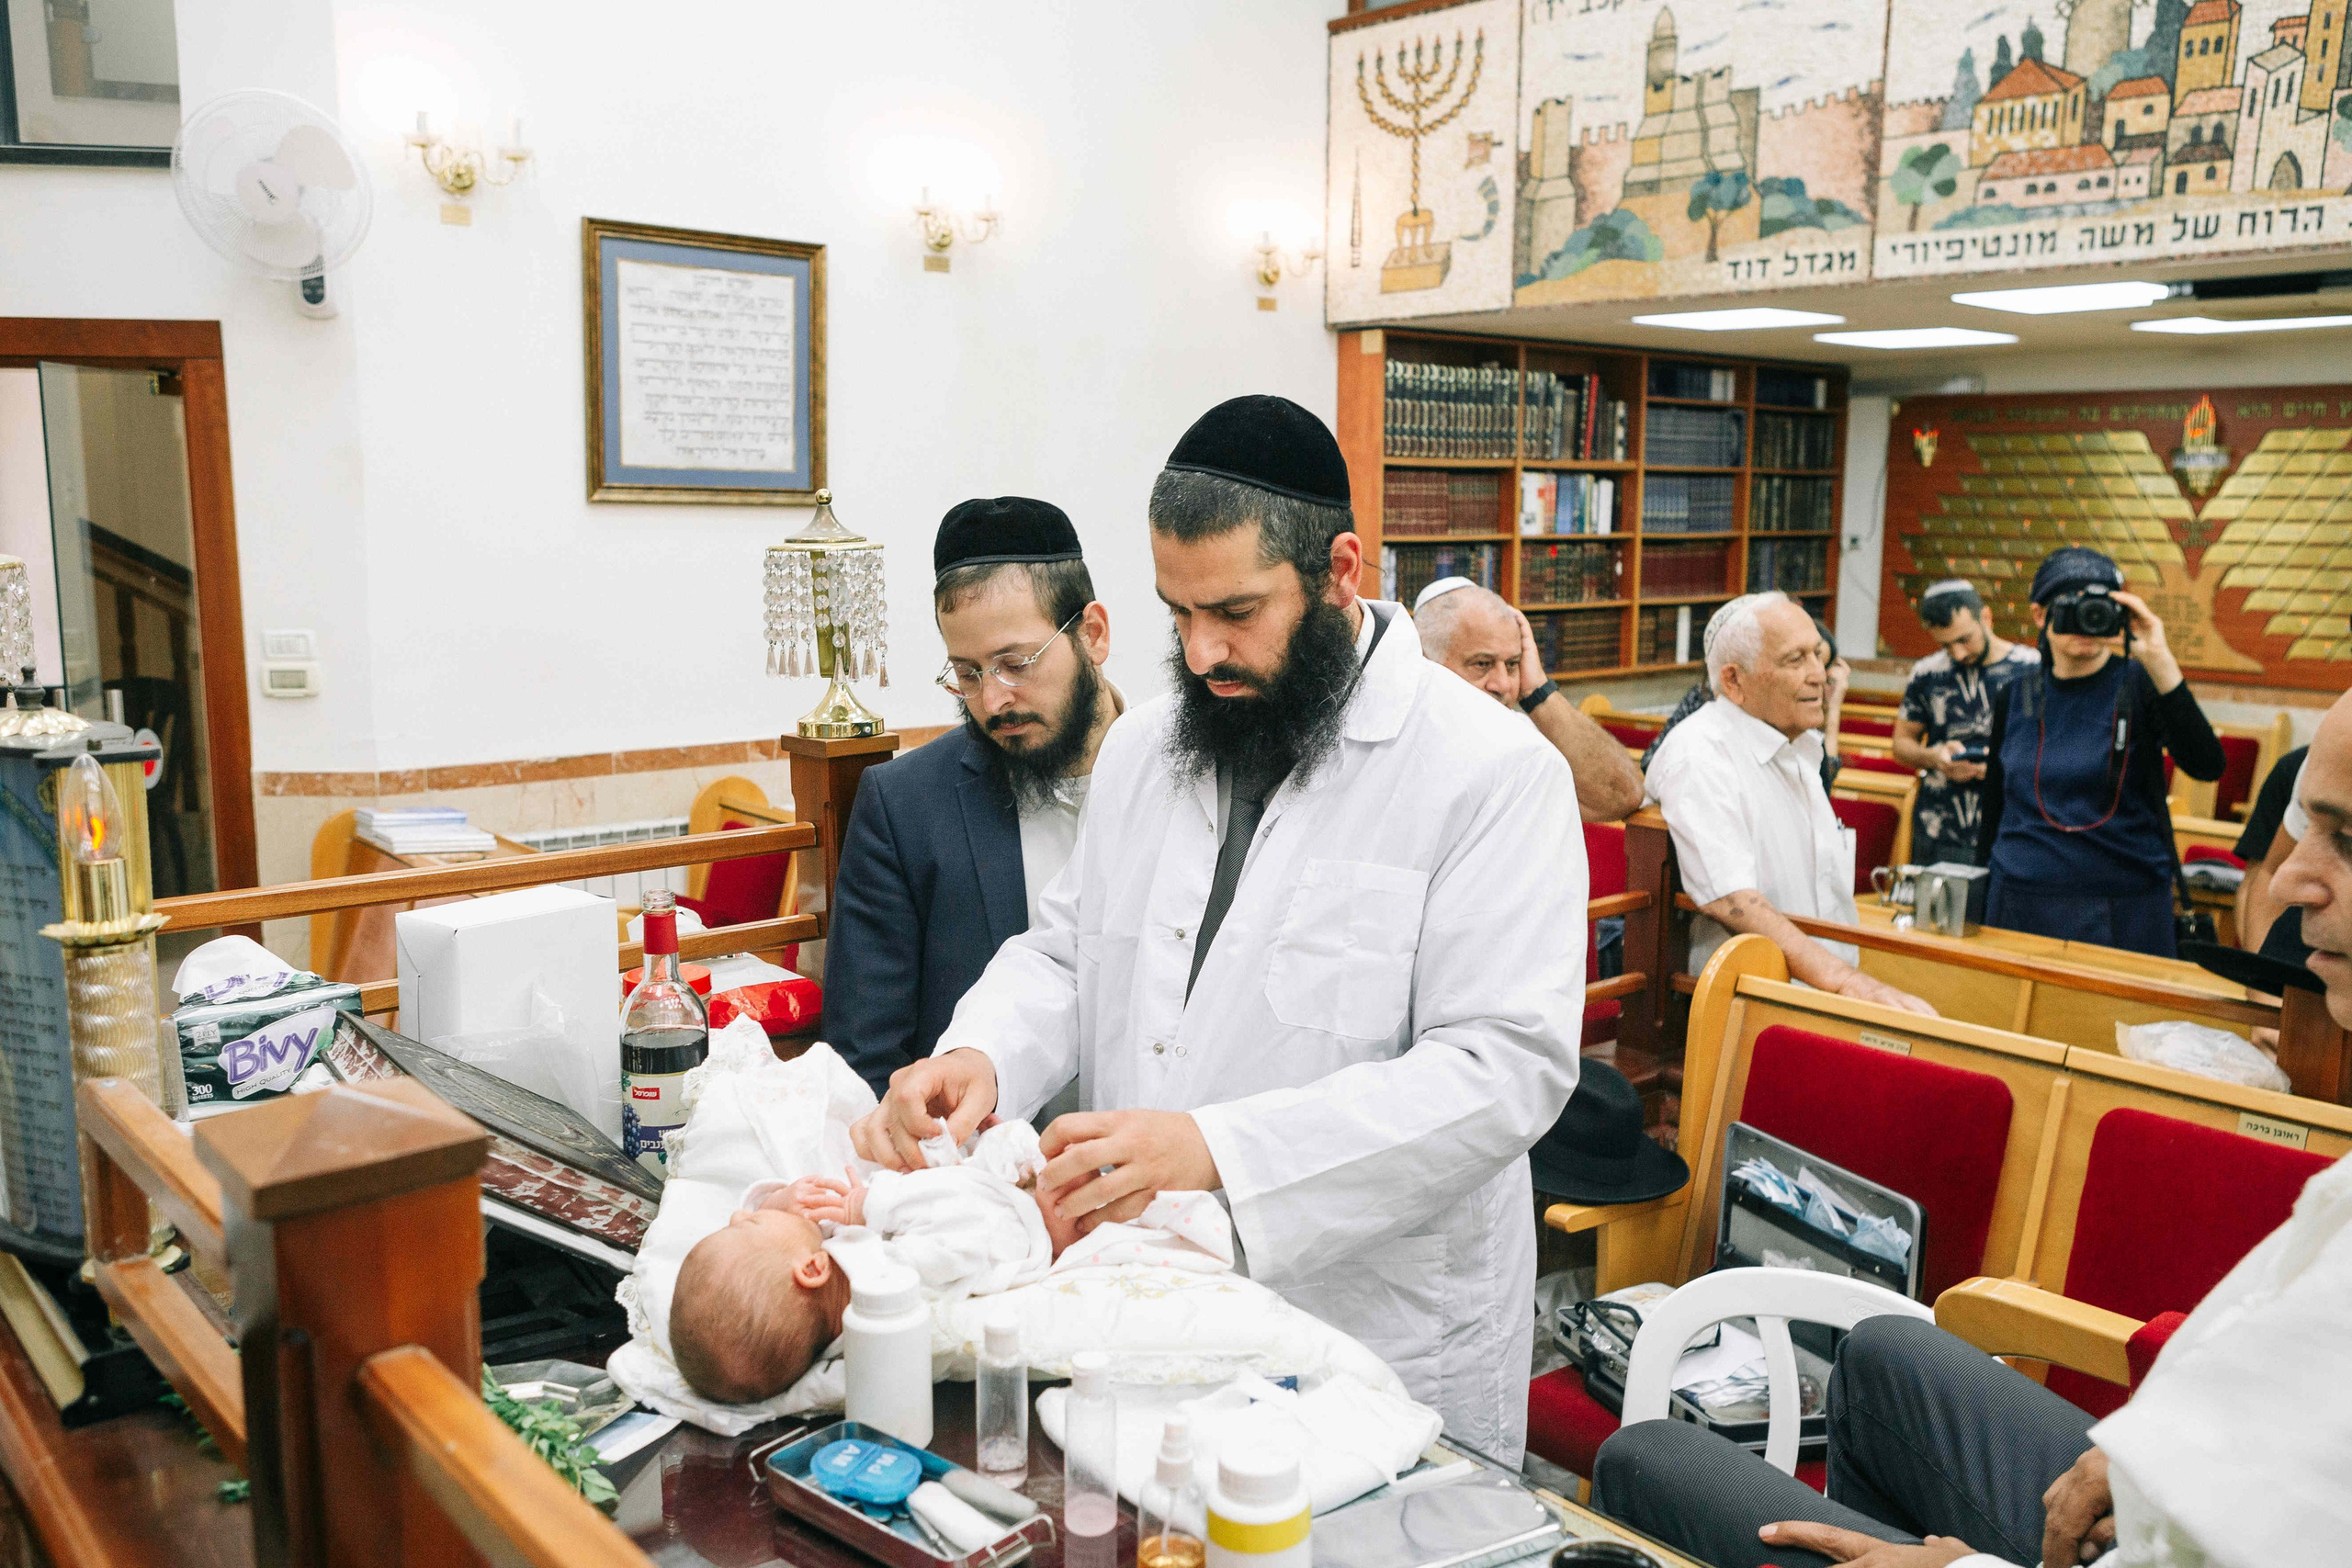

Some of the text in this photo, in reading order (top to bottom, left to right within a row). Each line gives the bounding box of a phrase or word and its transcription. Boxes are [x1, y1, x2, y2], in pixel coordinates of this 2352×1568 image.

[1890, 205, 2324, 264] הרוח של משה מונטיפיורי
[1726, 249, 1856, 279] מגדל דוד
[223, 1027, 319, 1084] Bivy
[191, 1084, 212, 1096] 300
[236, 1067, 291, 1094] HIGH QUALITY
